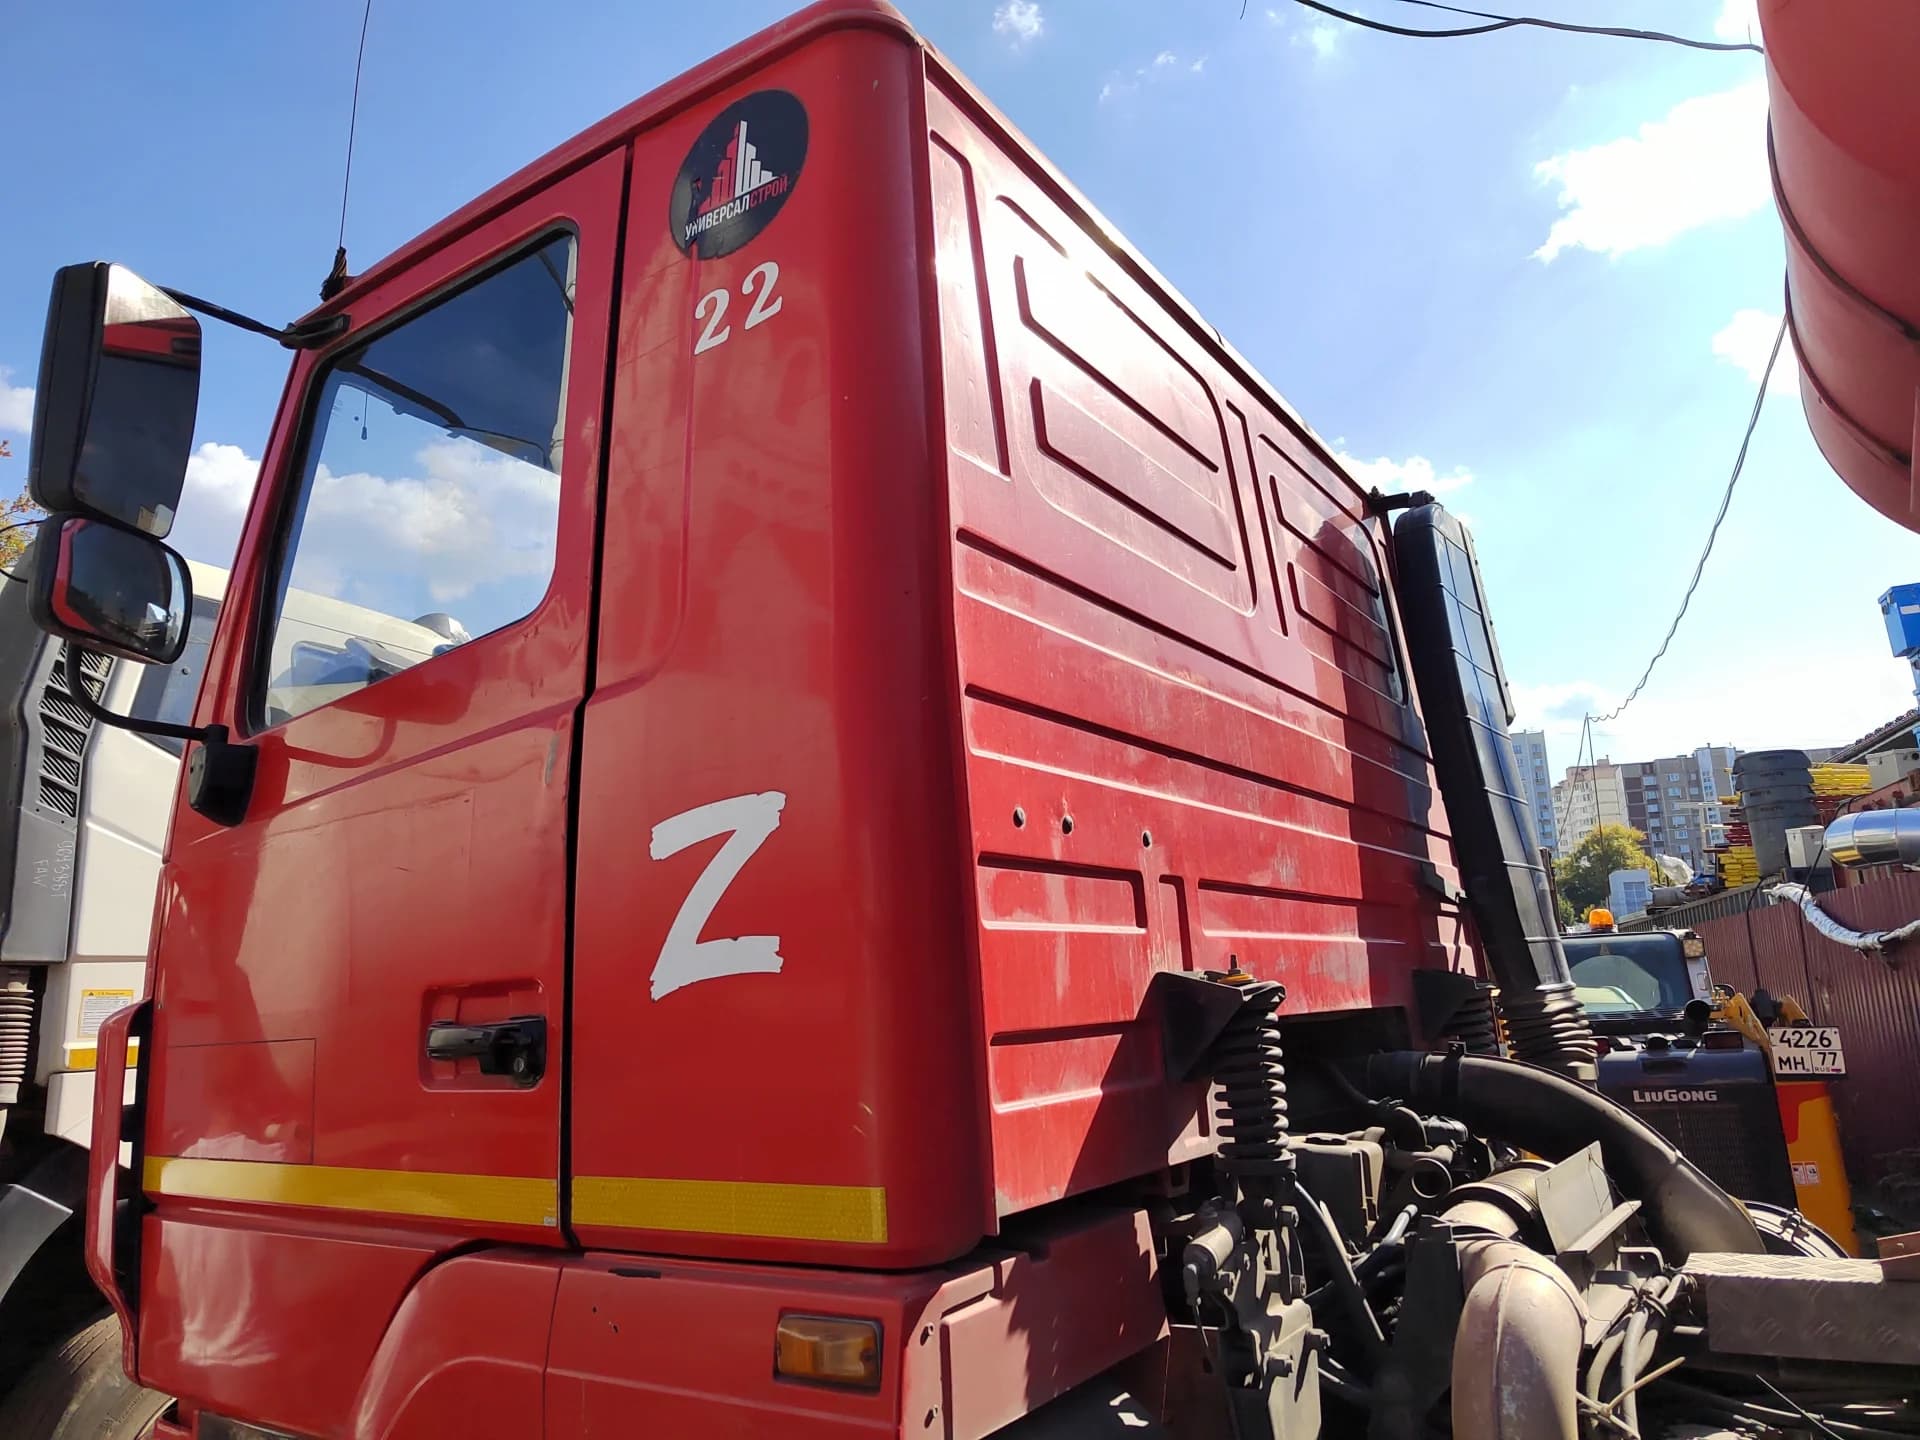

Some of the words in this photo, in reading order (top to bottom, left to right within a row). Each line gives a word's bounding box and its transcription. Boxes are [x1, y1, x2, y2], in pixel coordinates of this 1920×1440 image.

[684, 174, 788, 240] УНИВЕРСАЛСТРОЙ
[650, 790, 787, 1001] Z
[1779, 1030, 1832, 1048] 4226
[1816, 1051, 1837, 1066] 77
